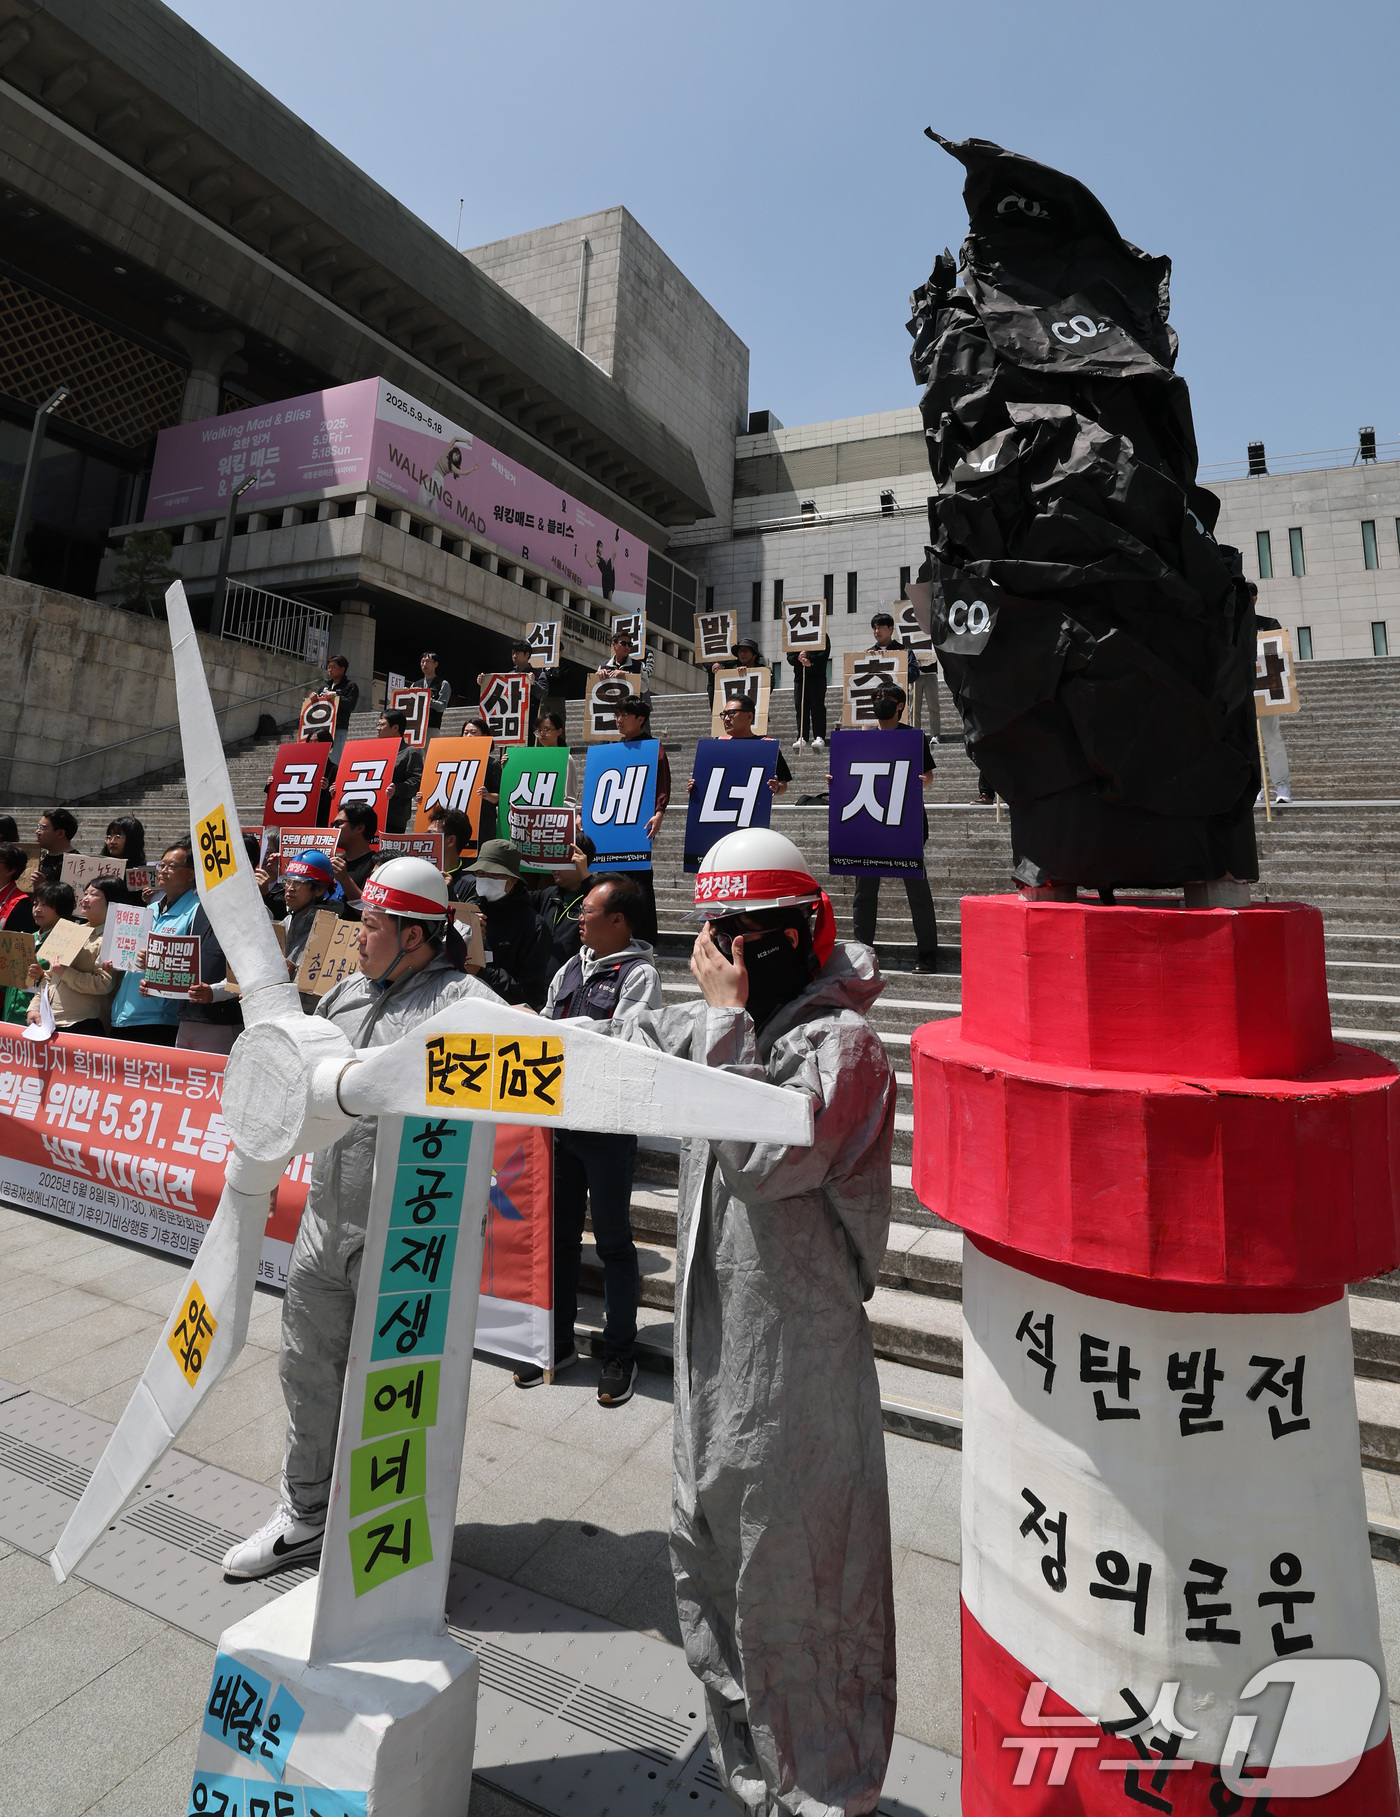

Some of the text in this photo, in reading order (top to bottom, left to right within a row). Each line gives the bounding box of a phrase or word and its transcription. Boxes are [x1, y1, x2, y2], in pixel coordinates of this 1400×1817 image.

[202, 408, 311, 443] Walking Mad & Bliss
[231, 432, 271, 451] 요한 잉거
[320, 418, 348, 431] 2025.
[218, 446, 280, 477] 워킹 매드
[217, 480, 227, 497] &
[389, 443, 486, 534] WALKING MAD
[537, 517, 544, 531] &
[547, 518, 574, 540] 블리스
[700, 614, 730, 654] 발
[788, 604, 821, 642] 전
[527, 623, 557, 662] 석
[484, 680, 522, 738] 삶
[272, 763, 319, 814] 공
[338, 759, 389, 804] 공
[424, 759, 481, 813] 재
[590, 765, 649, 826] 에
[697, 766, 766, 828] 너
[839, 759, 911, 827] 지
[282, 834, 336, 845] 모두의 삶을 지키는
[413, 840, 434, 853] 막고
[531, 829, 565, 843] 만드는
[543, 843, 571, 858] 전환!
[68, 859, 86, 878] 기후
[128, 870, 149, 887] 531
[148, 938, 194, 957] 노동자·시민이
[164, 956, 191, 972] 만드는
[145, 968, 196, 987] 정의로운 전환!
[73, 1048, 116, 1083] 확대!
[45, 1082, 101, 1133] 위한
[99, 1093, 166, 1150] 5.31.
[41, 1133, 198, 1213] 선포 기자회견
[38, 1171, 205, 1235] 2025년 5월 8일(목) 11:30, 세종문화회관
[78, 1202, 150, 1239] 기후위기비상행동
[174, 1299, 213, 1373] 공유
[1015, 1309, 1310, 1440] 석탄발전
[1018, 1486, 1315, 1657] 정의로운
[208, 1674, 281, 1759] 바람은
